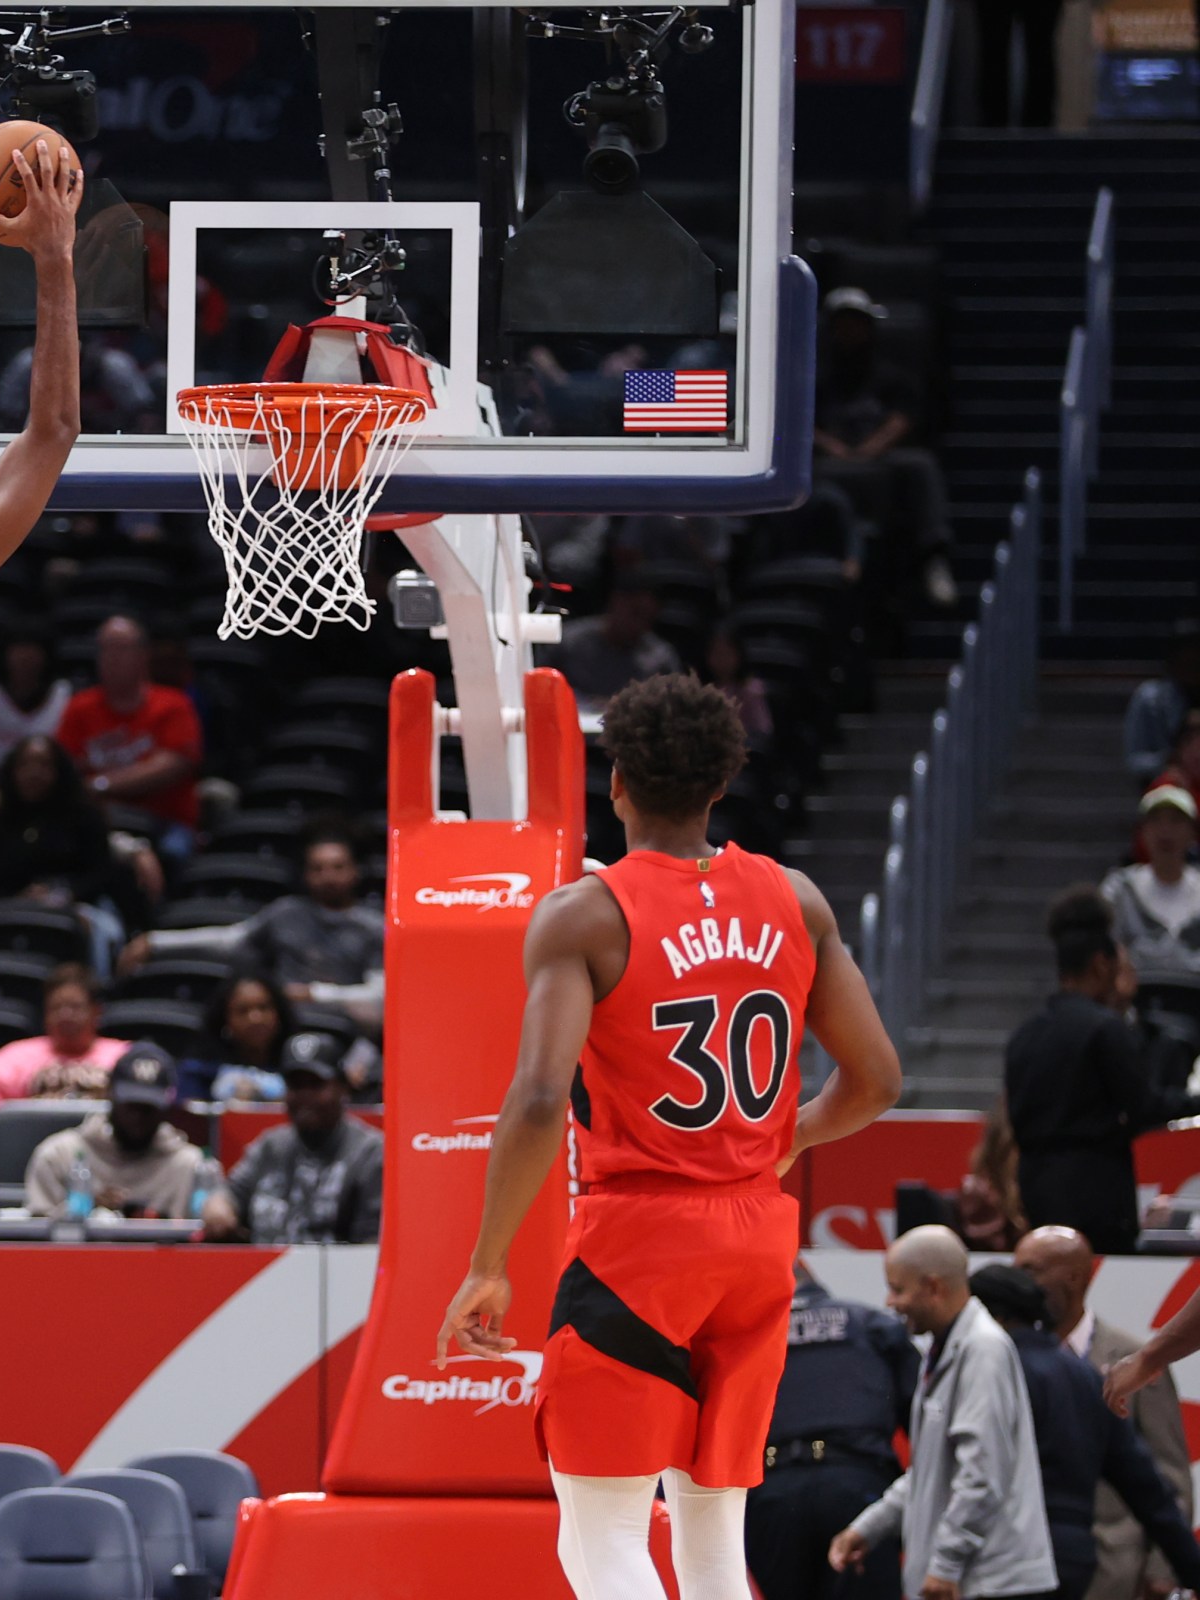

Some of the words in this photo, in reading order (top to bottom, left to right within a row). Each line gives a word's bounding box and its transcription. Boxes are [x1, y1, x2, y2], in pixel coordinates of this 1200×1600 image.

[806, 22, 886, 70] 117
[660, 916, 785, 980] AGBAJI
[647, 989, 793, 1132] 30
